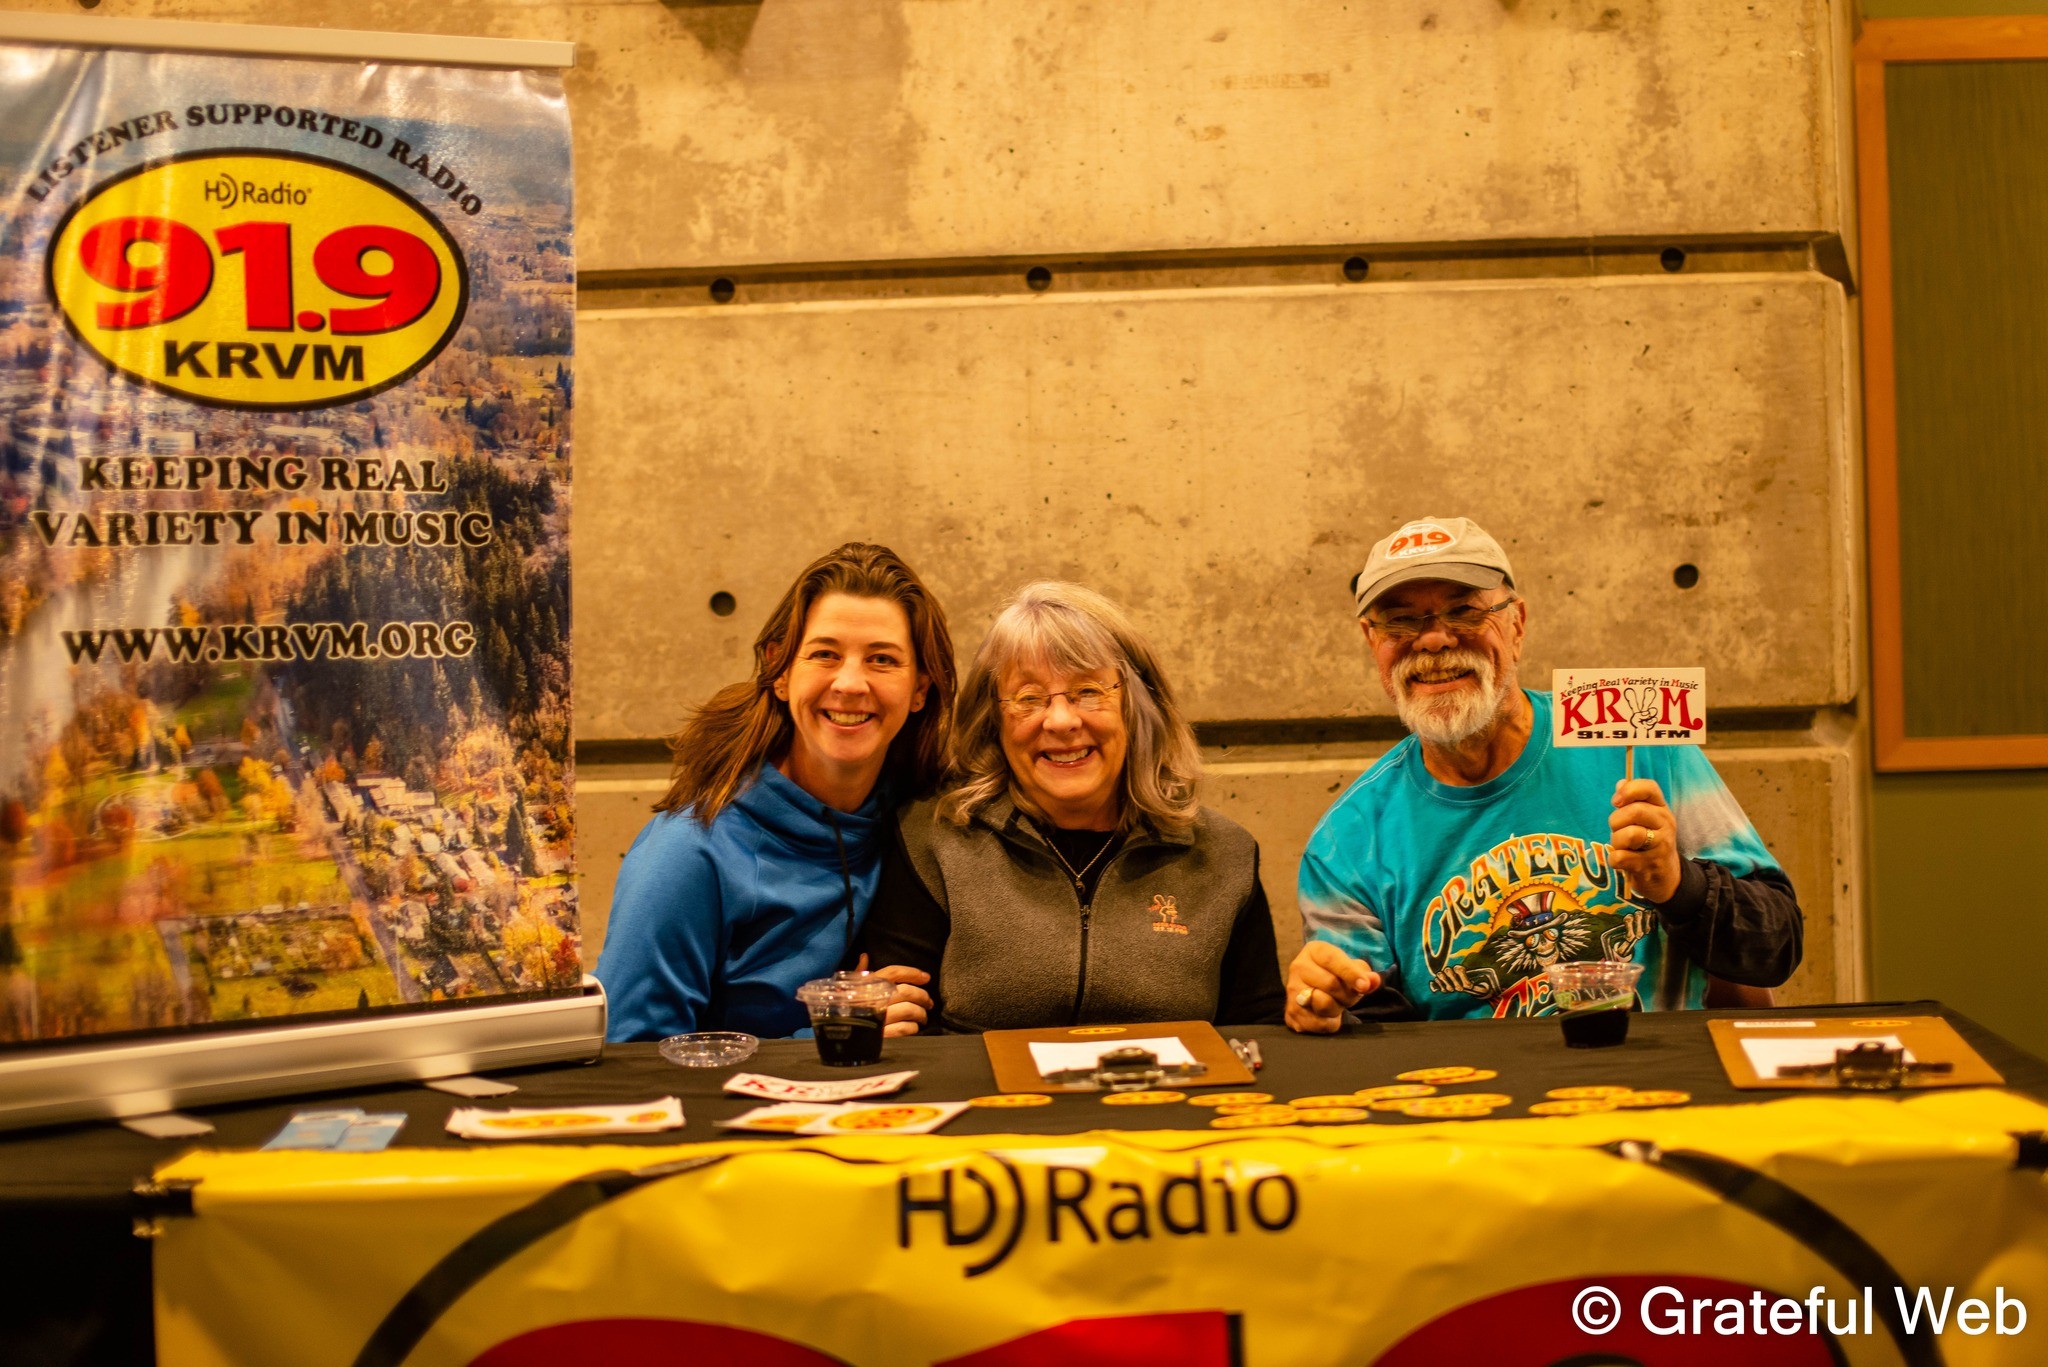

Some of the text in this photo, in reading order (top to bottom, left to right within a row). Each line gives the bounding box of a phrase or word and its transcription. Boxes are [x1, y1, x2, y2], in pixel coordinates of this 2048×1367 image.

[26, 103, 483, 216] LISTENER SUPPORTED RADIO
[79, 216, 442, 336] 91.9
[164, 340, 365, 381] KRVM
[79, 456, 448, 493] KEEPING REAL
[31, 510, 492, 547] VARIETY IN MUSIC
[1389, 531, 1451, 556] 91.9
[61, 622, 476, 664] WWW.KRVM.ORG
[1560, 677, 1699, 701] Keeping Real Variety in Music
[1577, 730, 1691, 739] 91.9 FM
[1046, 1161, 1300, 1245] Radio
